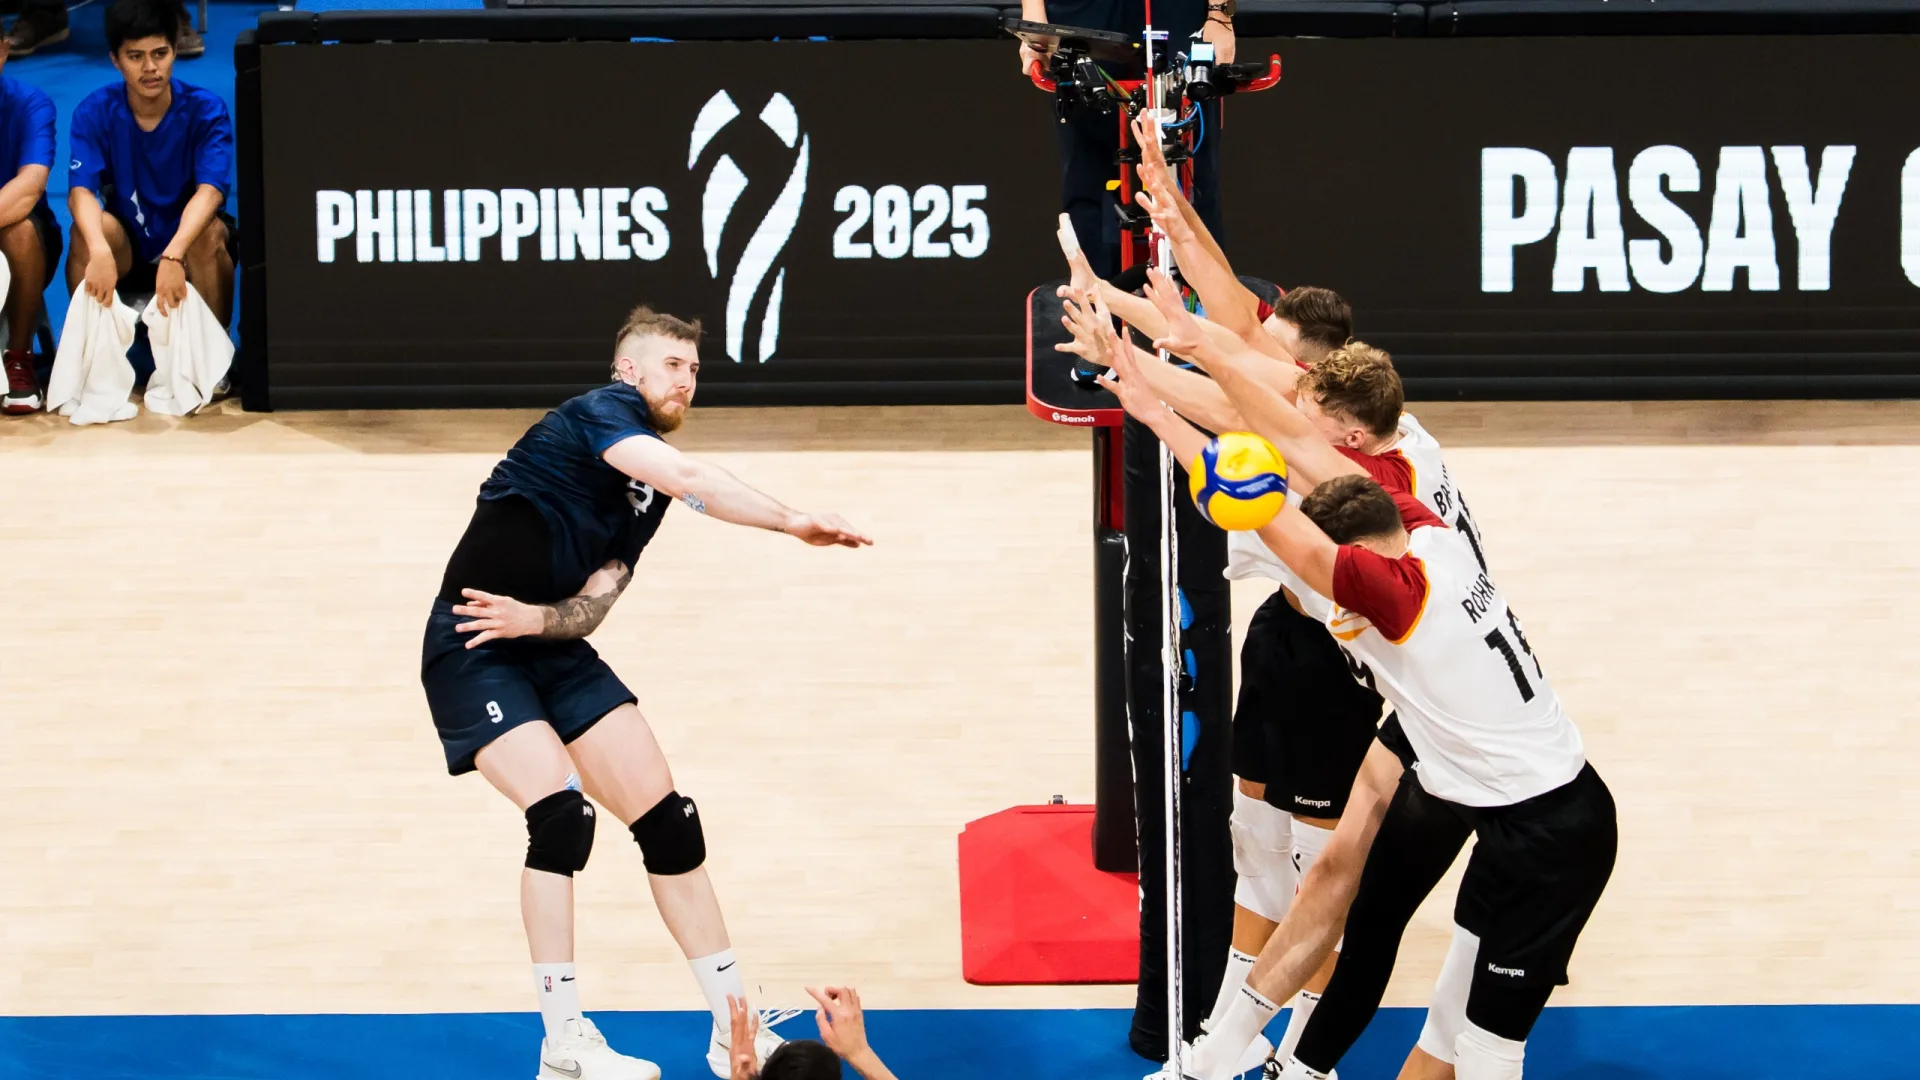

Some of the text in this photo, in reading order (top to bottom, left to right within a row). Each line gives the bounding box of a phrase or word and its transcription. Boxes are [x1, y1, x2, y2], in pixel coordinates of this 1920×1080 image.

[316, 185, 990, 262] PHILIPPINES 2025
[1482, 145, 1856, 293] PASAY
[1060, 414, 1095, 423] Senoh
[1461, 573, 1496, 624] RÖHR
[486, 700, 504, 723] 9
[1294, 795, 1331, 809] Kempa
[1488, 962, 1525, 978] Kempa
